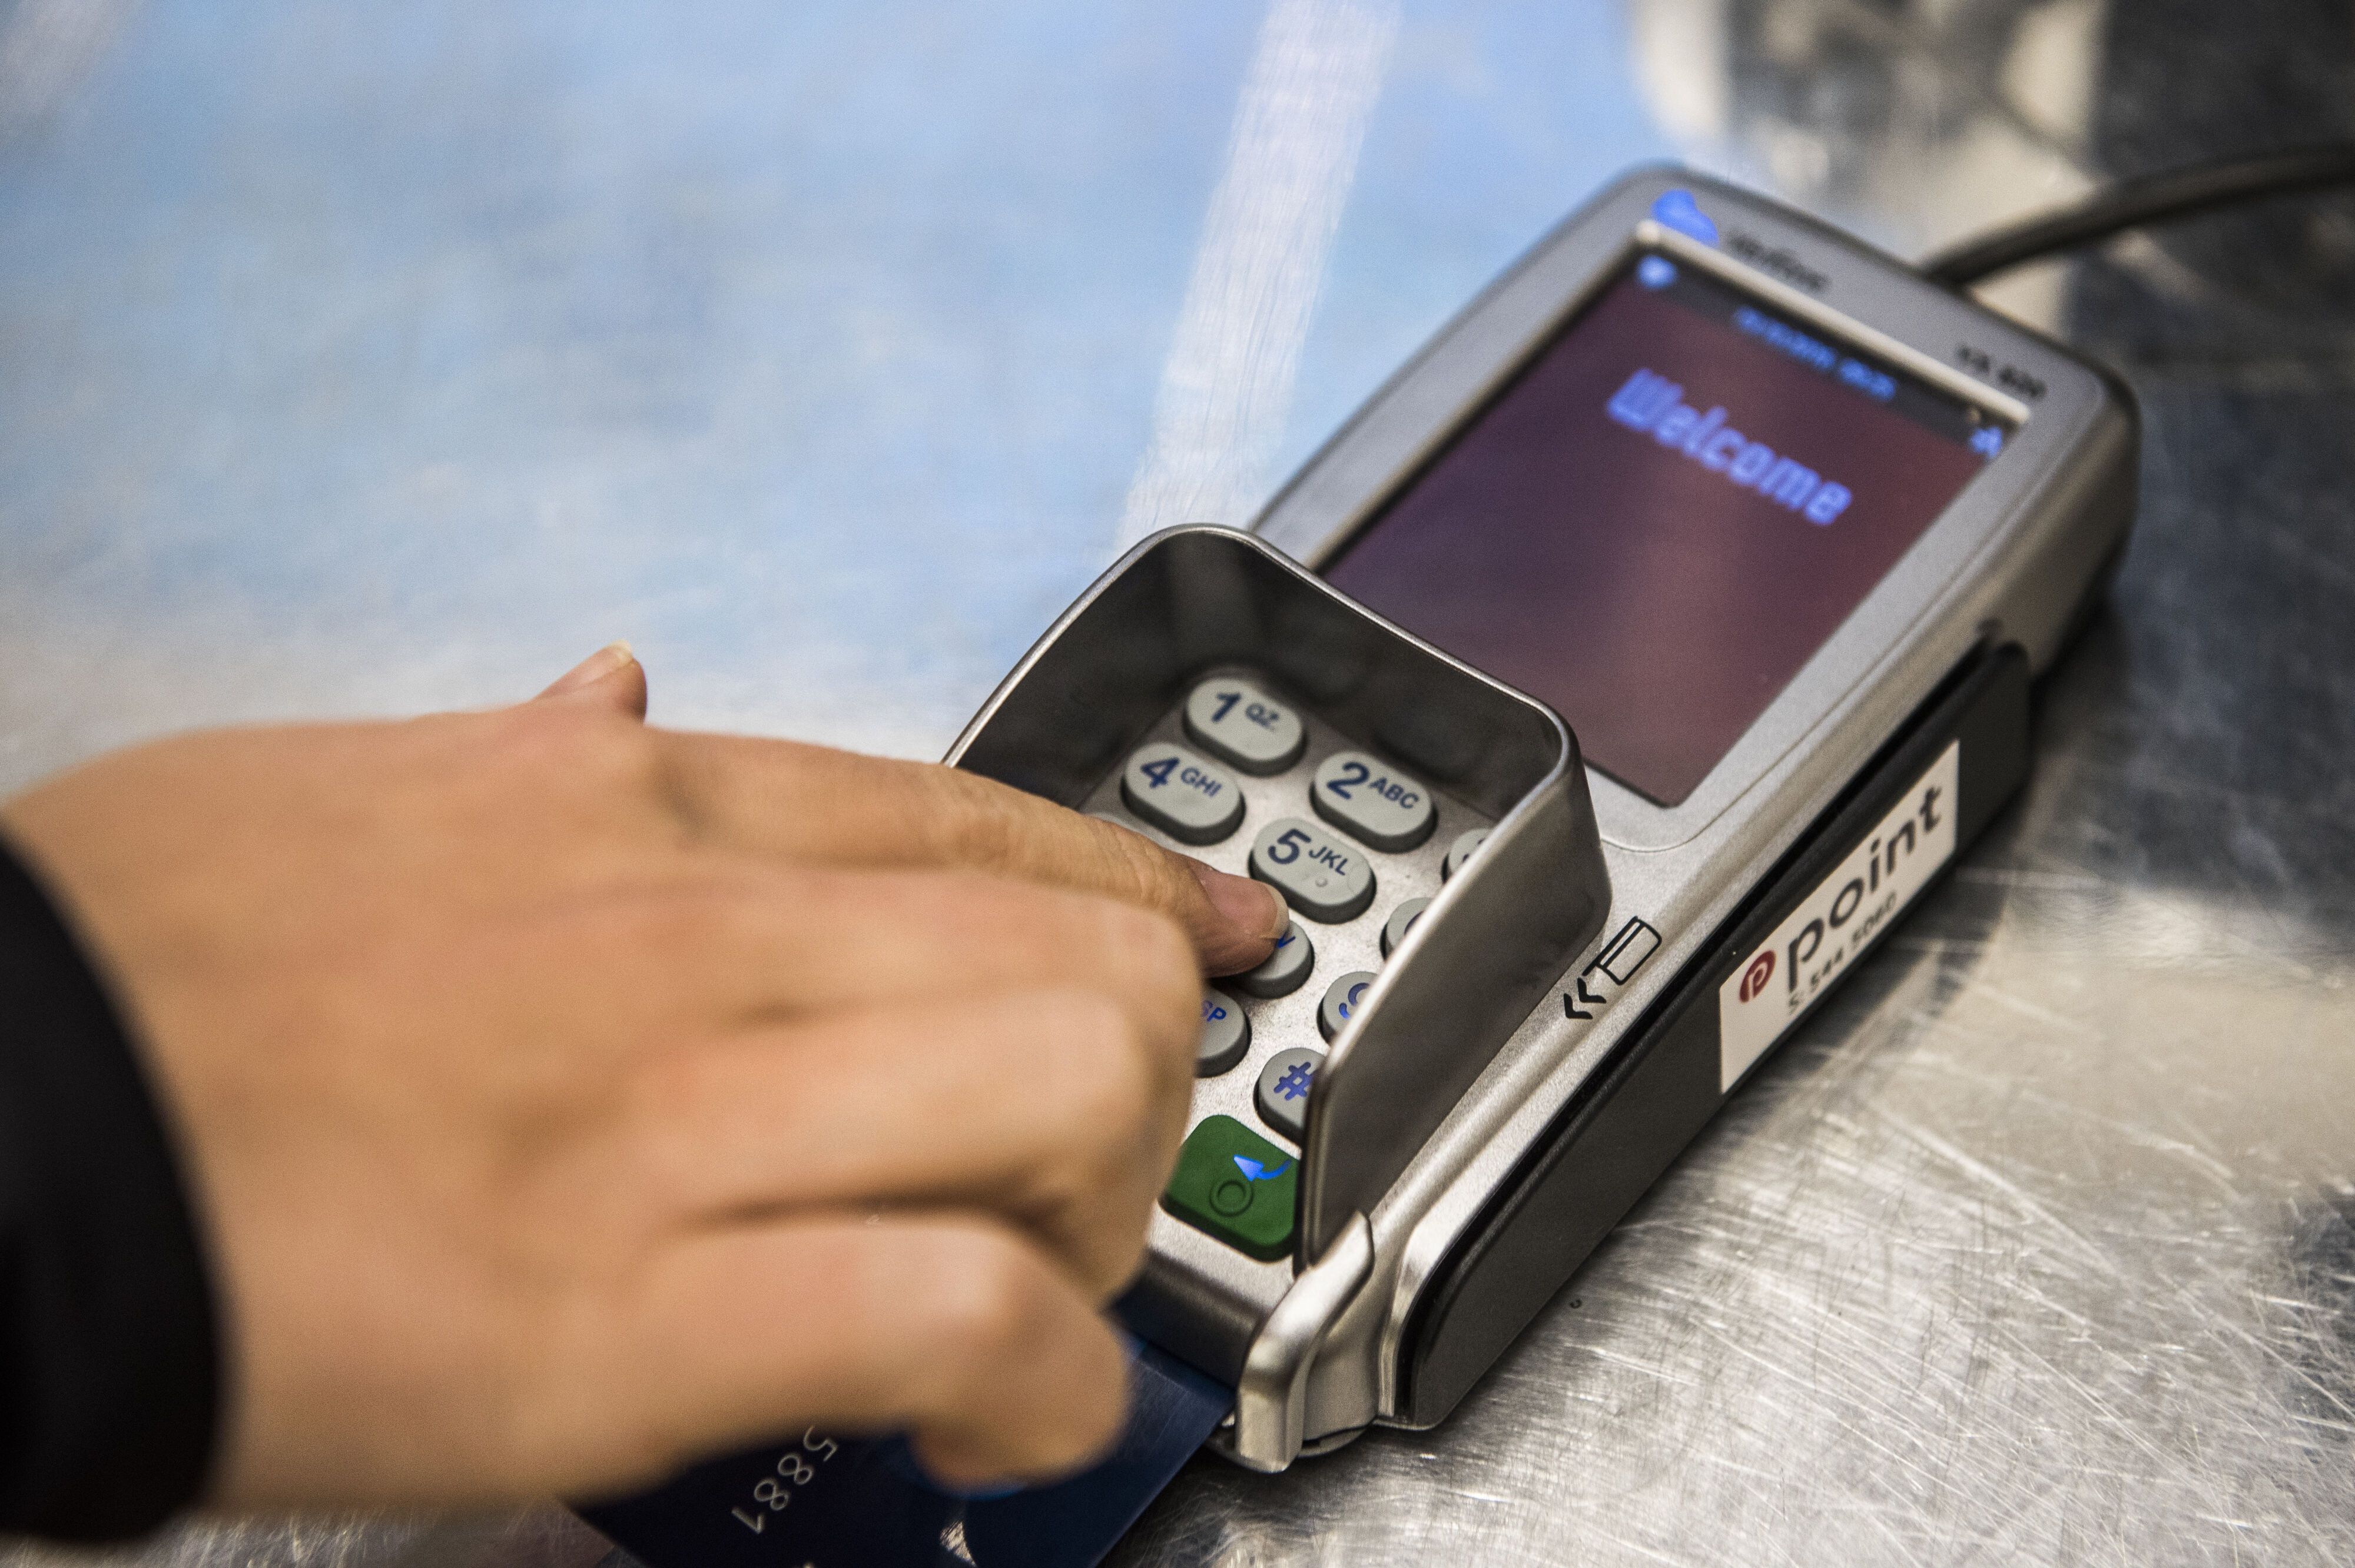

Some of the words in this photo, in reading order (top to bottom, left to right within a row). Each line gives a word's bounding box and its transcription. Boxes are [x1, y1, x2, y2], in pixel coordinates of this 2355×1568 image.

[1607, 367, 1852, 525] Welcome
[1211, 692, 1242, 723] 1
[1141, 756, 1180, 789] 4
[1181, 767, 1222, 797] GHI
[1327, 762, 1370, 800] 2
[1369, 777, 1419, 809] ABC
[1268, 828, 1312, 865] 5
[1309, 846, 1348, 876] JKL
[1788, 785, 1942, 993] point
[731, 1425, 838, 1534] 5881
